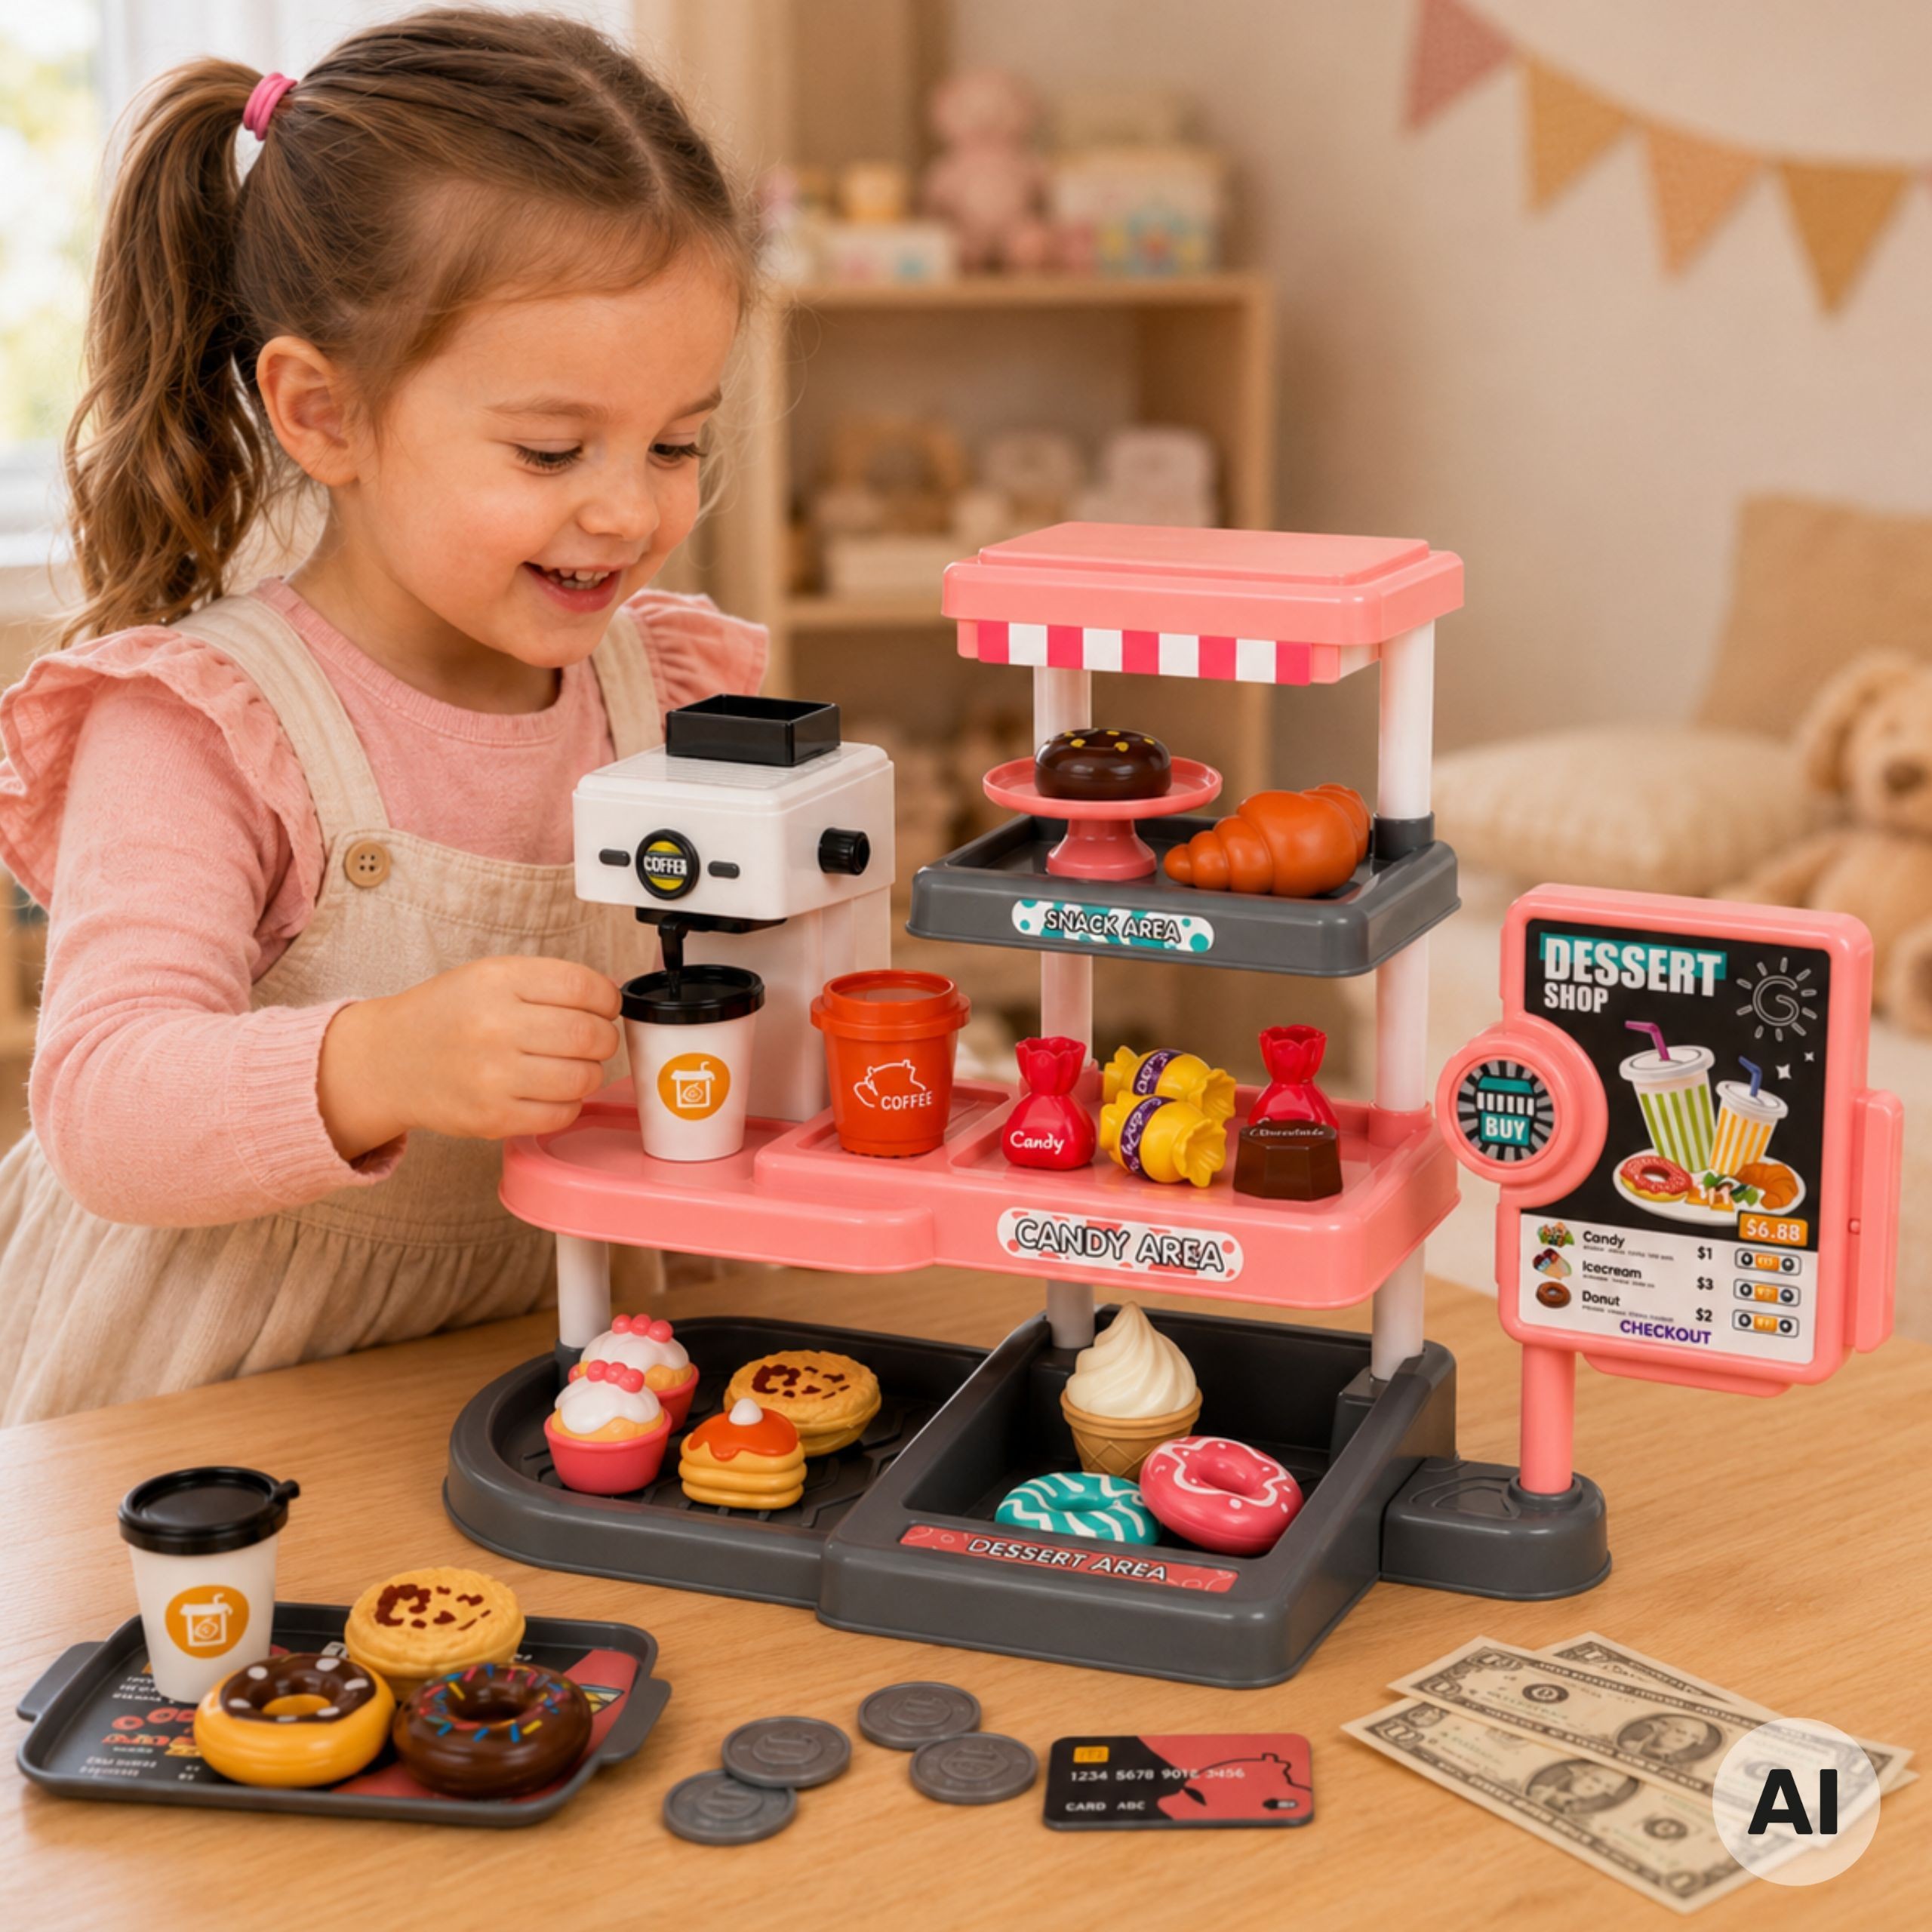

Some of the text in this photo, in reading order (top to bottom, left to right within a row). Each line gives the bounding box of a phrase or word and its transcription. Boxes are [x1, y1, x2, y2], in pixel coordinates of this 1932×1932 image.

[1044, 909, 1181, 943] SNACK AREA
[1544, 938, 1722, 997] DESSERT
[1544, 982, 1609, 1014] SHOP
[880, 1091, 933, 1111] COFFEE
[1009, 1129, 1065, 1155] Candy
[1484, 1115, 1525, 1140] BUY
[1746, 1218, 1801, 1241] $6.88
[1015, 1218, 1225, 1273] CANDY AREA
[1583, 1230, 1713, 1260] Candy $1
[1582, 1260, 1714, 1291] Icecream $3
[1581, 1290, 1713, 1323] Donut $2
[1619, 1318, 1712, 1345] CHECKOUT
[968, 1539, 1165, 1580] DESSERT AREA
[1070, 1770, 1109, 1782] 1234
[1115, 1769, 1155, 1781] 5678
[1065, 1801, 1108, 1812] CARD
